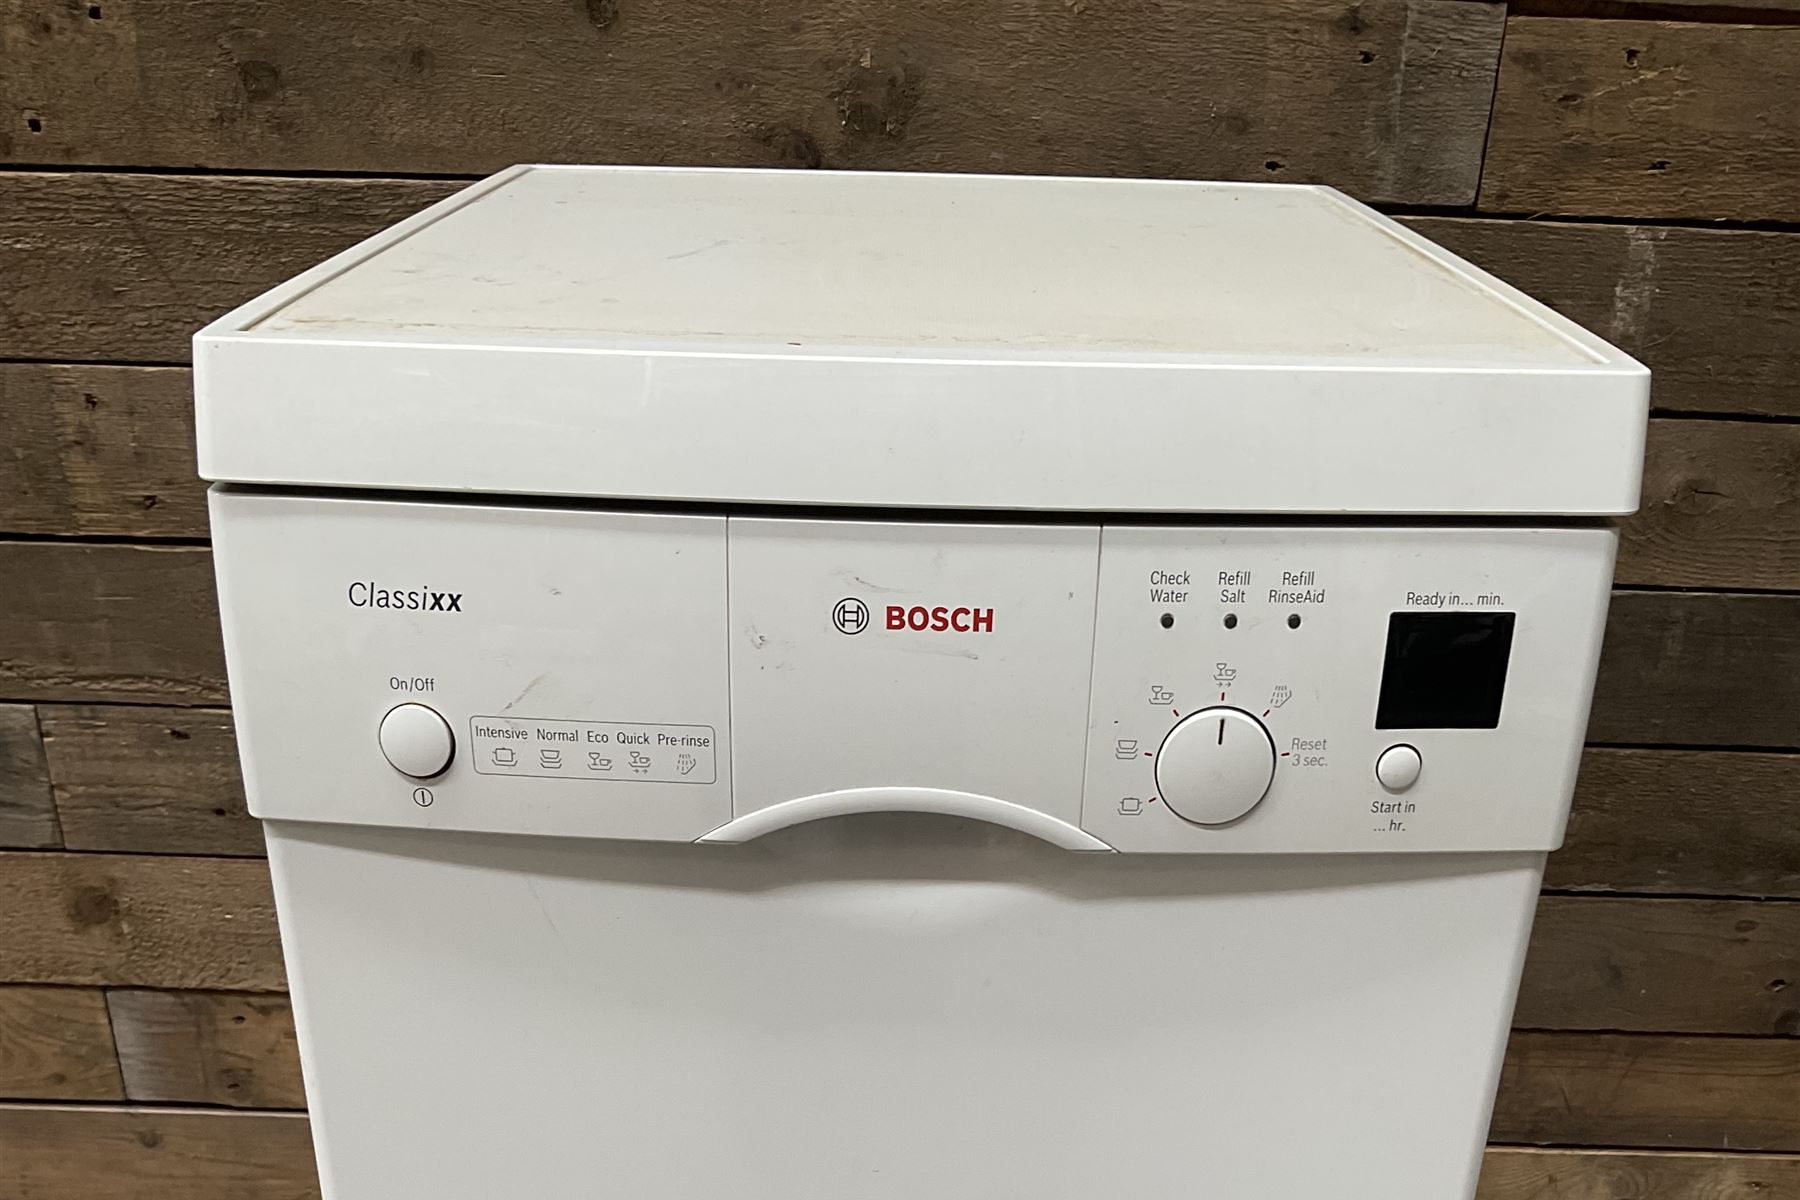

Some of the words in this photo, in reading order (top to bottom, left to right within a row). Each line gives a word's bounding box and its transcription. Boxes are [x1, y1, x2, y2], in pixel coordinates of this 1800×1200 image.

[1151, 571, 1190, 585] Check
[1219, 571, 1250, 585] Refill
[1283, 571, 1314, 585] Refill
[349, 582, 462, 612] Classixx
[1151, 589, 1188, 602] Water
[1221, 589, 1245, 603] Salt
[1269, 589, 1325, 603] RinseAid
[1407, 592, 1446, 608] Ready
[1477, 592, 1504, 605] min.
[886, 606, 993, 632] BOSCH
[390, 677, 434, 692] On/Off
[476, 726, 528, 739] Intensive
[537, 729, 578, 741] Normal
[587, 731, 608, 743] Eco
[617, 732, 650, 744] Quick
[658, 734, 709, 747] Pre-rinse
[1292, 738, 1327, 750] Reset
[1292, 754, 1300, 766] 3
[1303, 756, 1328, 767] sec.
[1371, 801, 1401, 813] Start
[1405, 801, 1415, 813] in
[1389, 819, 1405, 831] hr.
